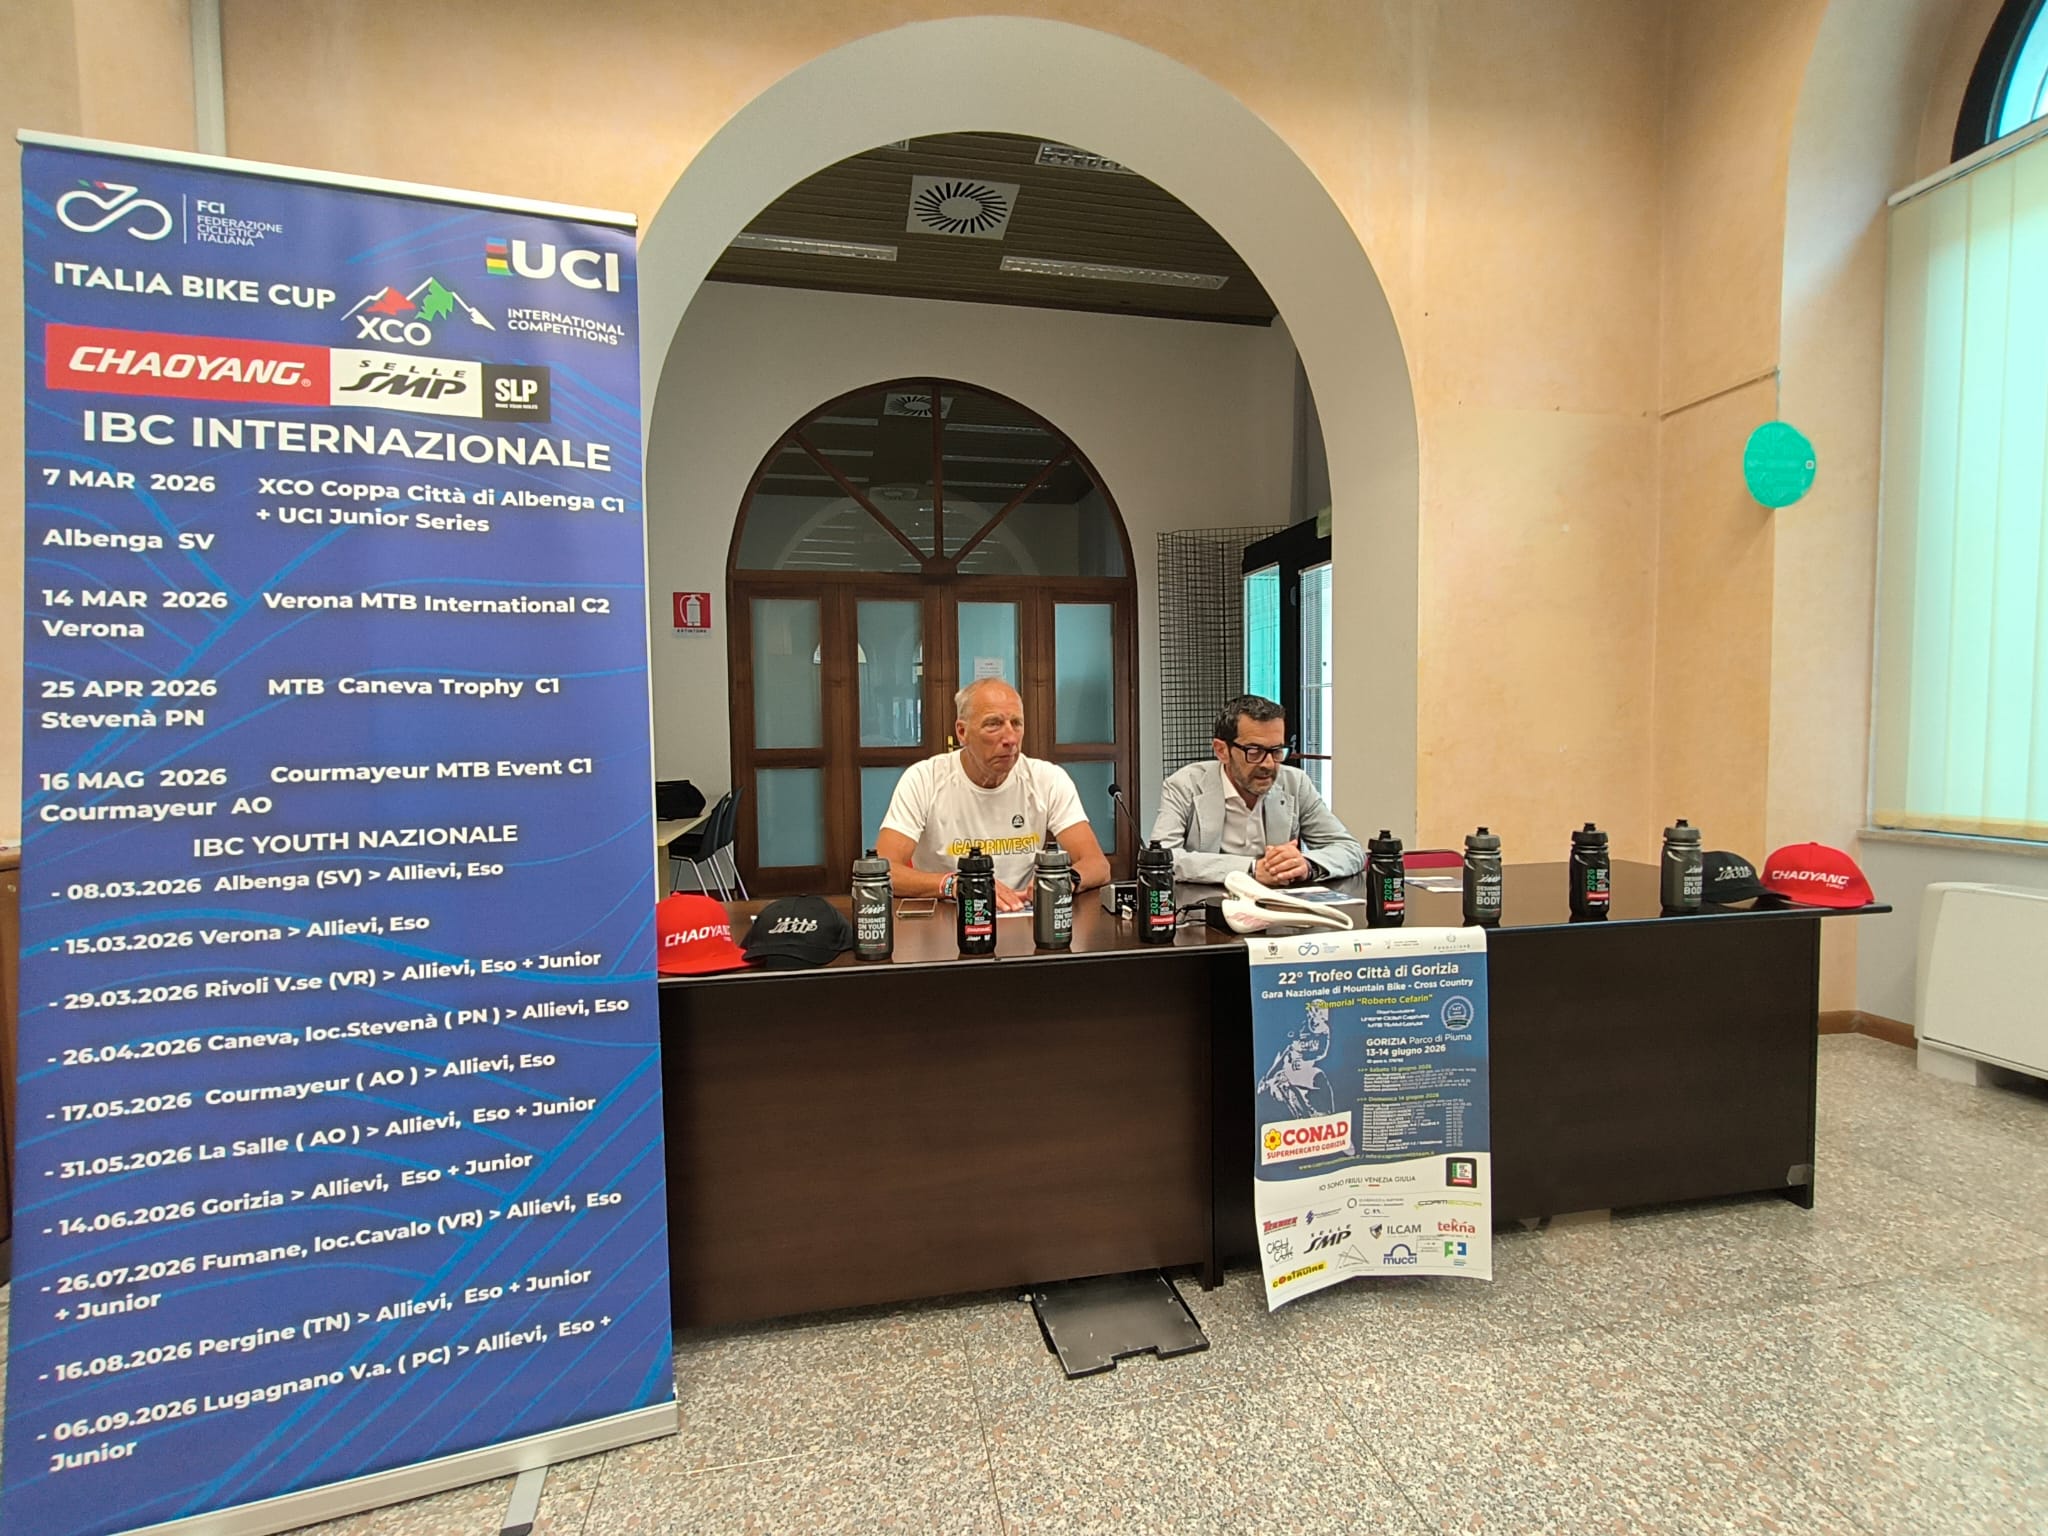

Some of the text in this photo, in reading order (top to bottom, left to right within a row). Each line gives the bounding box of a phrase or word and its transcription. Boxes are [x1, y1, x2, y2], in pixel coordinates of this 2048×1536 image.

[197, 200, 225, 214] FCI
[197, 215, 283, 234] FEDERAZIONE
[197, 224, 264, 239] CICLISTICA
[197, 232, 255, 247] ITALIANA
[512, 240, 619, 292] UCI
[55, 262, 336, 309] ITALIA BIKE CUP
[356, 315, 432, 346] XCO
[507, 308, 625, 336] INTERNATIONAL
[507, 320, 618, 345] COMPETITIONS
[359, 359, 466, 378] SELLE
[495, 378, 538, 402] SLP
[84, 410, 611, 472] IBC INTERNAZIONALE
[43, 468, 215, 492] 7 MAR 2026
[258, 478, 624, 513] XCO Coppa Città di Albenga C1
[278, 507, 490, 532] UCI Junior Series
[43, 528, 215, 552] Albenga SV
[42, 590, 228, 608] 14 MAR 2026
[263, 592, 610, 614] Verona MTB International C2
[42, 620, 144, 637] Verona
[42, 680, 217, 698] 25 APR 2026
[269, 678, 559, 698] MTB Caneva Trophy C1
[42, 709, 156, 729] Stevenà
[40, 768, 227, 790] 16 MAG 2026
[270, 758, 592, 783] Courmayeur MTB Event C1
[40, 797, 272, 822] Courmayeur AO
[194, 825, 518, 857] IBC YOUTH NAZIONALE
[67, 862, 503, 900] 08.03.2026 Albenga (SV) Allievi, Eso
[1384, 878, 1392, 900] 2026
[1772, 870, 1849, 884] CHAOYANG
[1150, 890, 1158, 914] 2026
[65, 916, 430, 954] 15.03.2026 Verona Allievi, Eso
[858, 930, 885, 940] BODY
[64, 951, 601, 1010] 29.03.2026 Rivoli V.se (VR) Allievi, Eso Junior
[1278, 962, 1459, 984] 22° Trofeo Città di Gorizia
[1262, 979, 1474, 999] Gara Nazionale di Mountain Bike Cross Country
[63, 999, 629, 1065] 26.04.2026 Caneva, loc.Stevenà Allievi, Eso
[1366, 1038, 1407, 1046] GORIZIA
[1409, 1036, 1432, 1044] Parco
[1366, 1044, 1446, 1057] 13-14 giugno 2026
[62, 1054, 555, 1121] 17.05.2026 Courmayeur Allievi, Eso
[60, 1096, 596, 1178] 31.05.2026 La Salle Allievi, Eso Junior
[1283, 1121, 1348, 1145] CONAD
[1267, 1146, 1320, 1159] SUPERMERCATO
[59, 1153, 533, 1236] 14.06.2026 Gorizia Allievi, Eso Junior
[1327, 1180, 1344, 1190] SONO
[1387, 1224, 1421, 1234] ILCAM
[1438, 1218, 1476, 1234] tekna
[57, 1193, 622, 1299] 26.07.2026 Fumane, loc.Cavalo (VR) Allievi, Eso
[76, 1293, 161, 1320] Junior
[55, 1270, 591, 1381] 16.08.2026 Pergine (TN) Allievi, Eso Junior
[54, 1320, 595, 1440] 06.09.2026 Lugagnano V.a. Allievi, Eso
[50, 1442, 136, 1472] Junior
